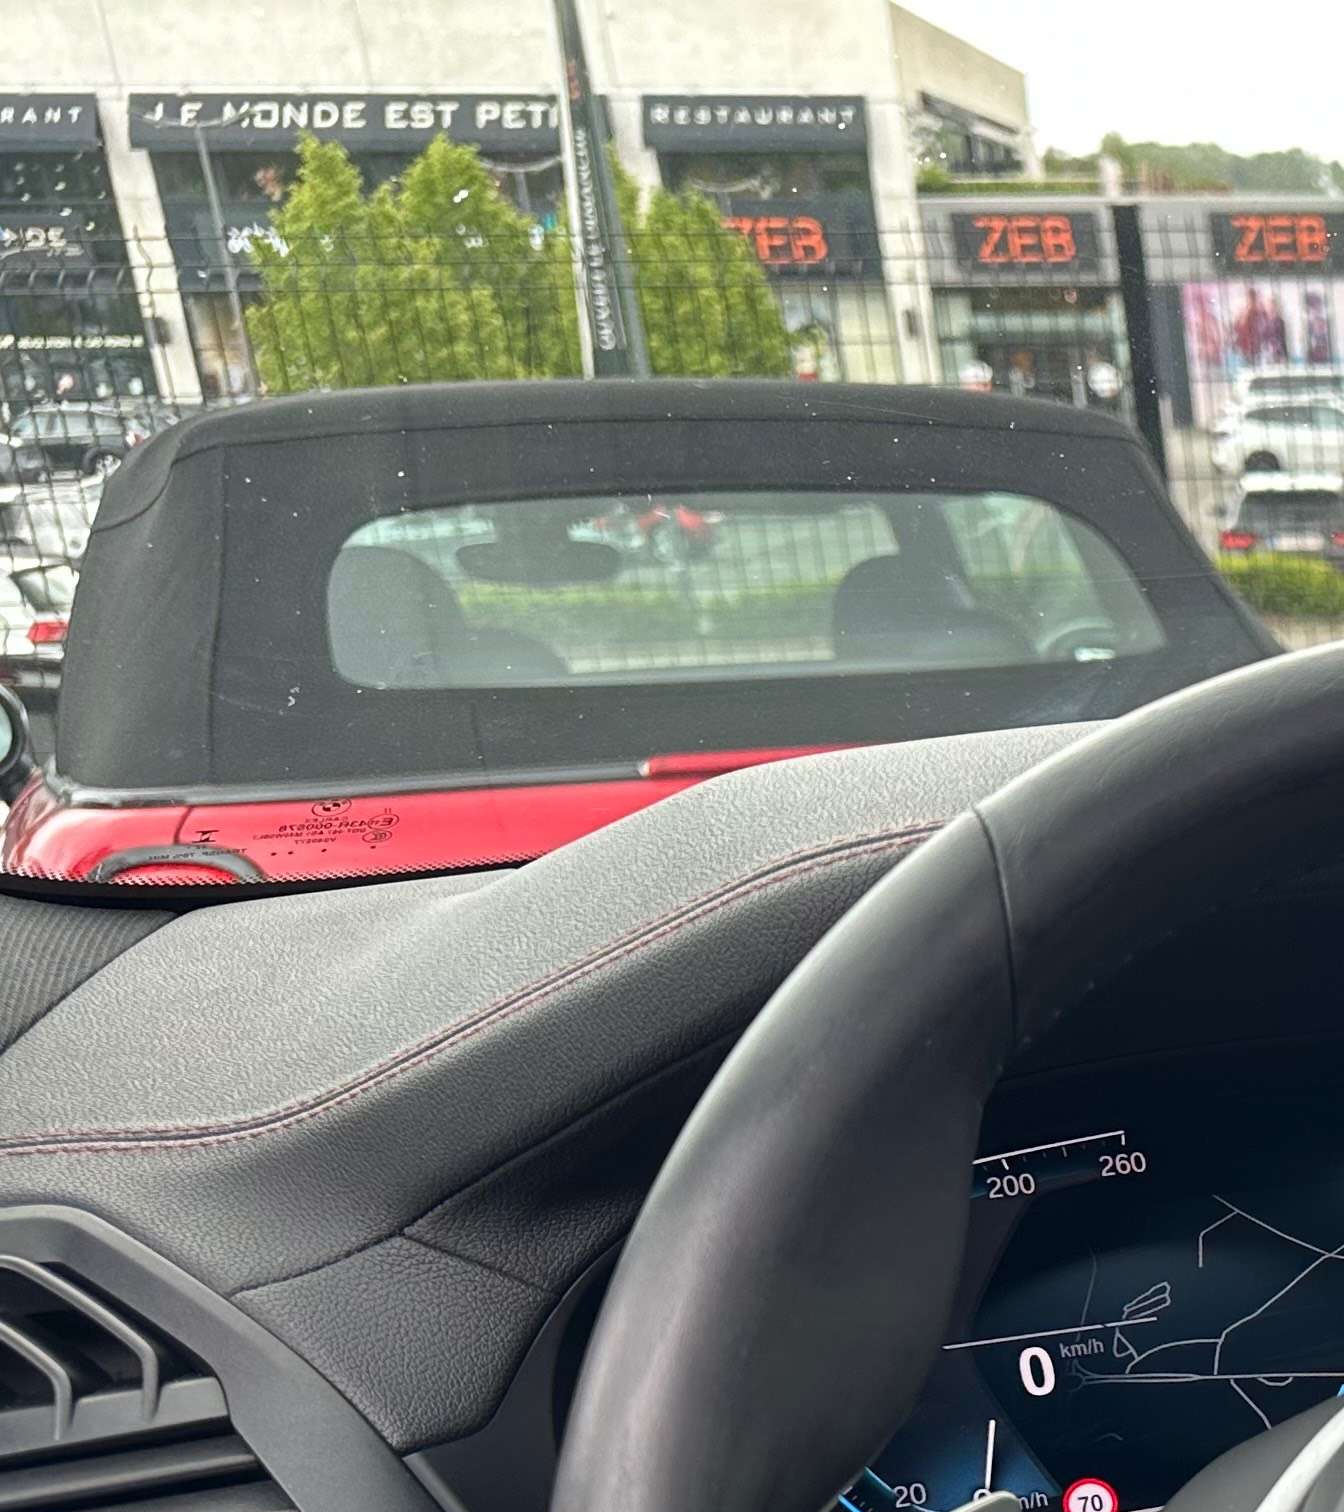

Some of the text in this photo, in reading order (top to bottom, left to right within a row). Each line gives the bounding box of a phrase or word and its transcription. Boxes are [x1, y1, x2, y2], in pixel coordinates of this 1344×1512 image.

[223, 102, 366, 129] MONDE
[385, 102, 460, 128] EST
[650, 104, 856, 125] RESTAURANT
[973, 214, 1077, 263] ZEB
[1231, 214, 1328, 263] ZEB
[986, 1151, 1147, 1200] 200 260
[1018, 1336, 1104, 1397] 0 km/h
[895, 1482, 927, 1508] 20
